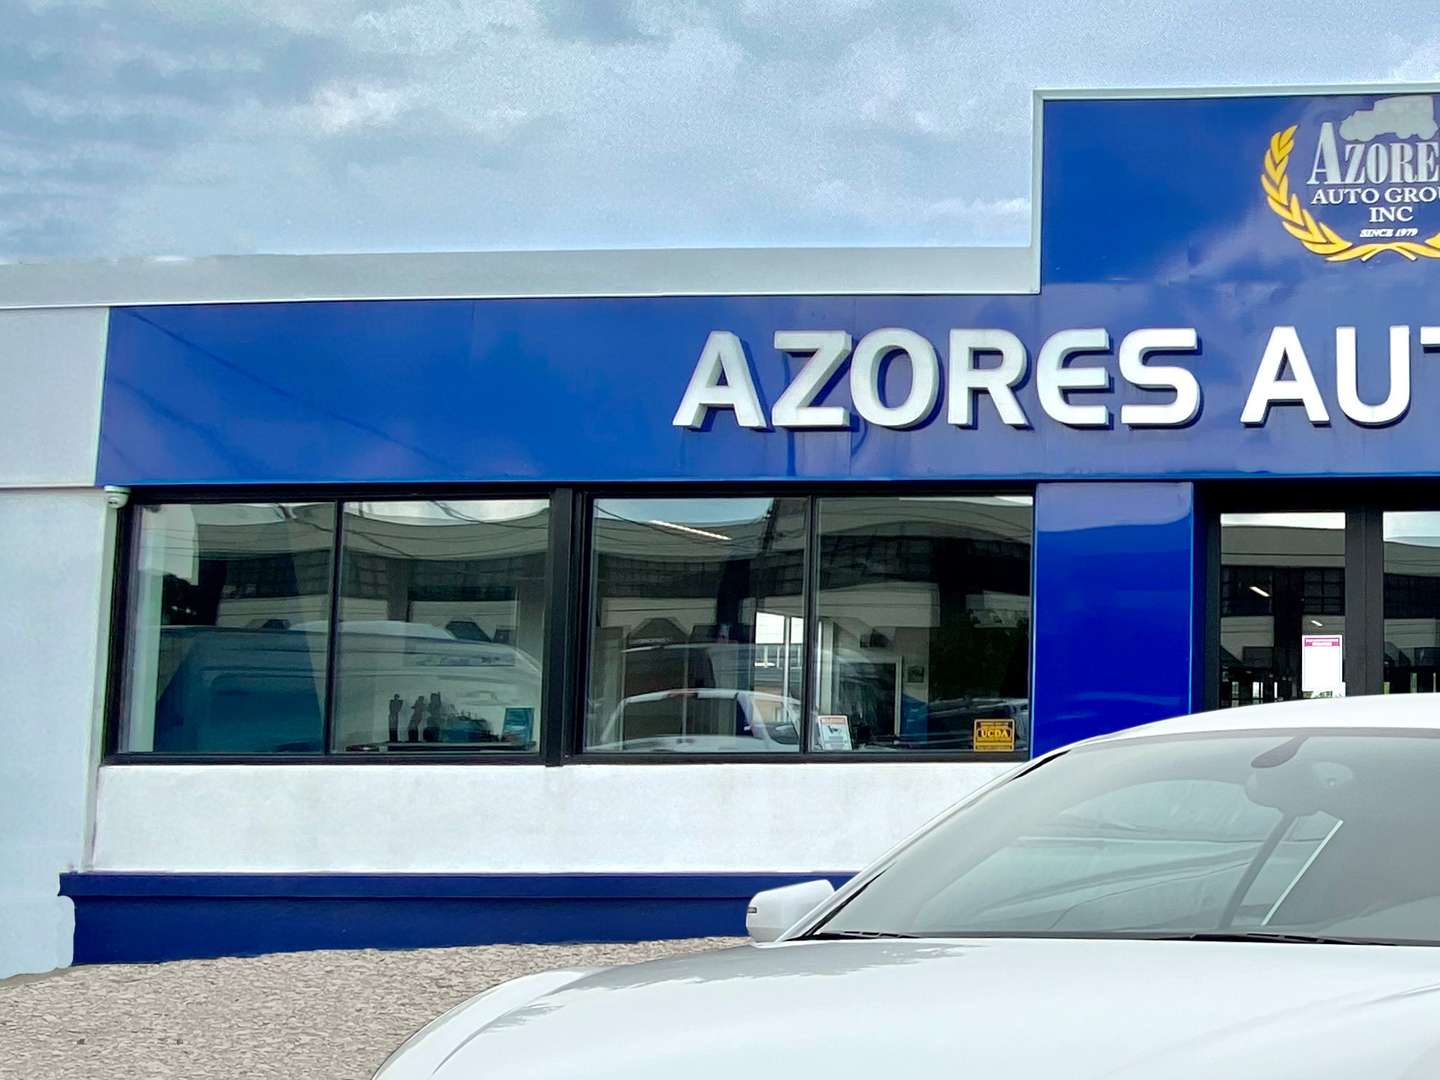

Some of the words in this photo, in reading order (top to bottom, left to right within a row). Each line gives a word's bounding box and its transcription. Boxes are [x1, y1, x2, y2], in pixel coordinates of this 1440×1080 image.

[1311, 187, 1379, 205] AUTO
[1368, 206, 1413, 222] INC
[1359, 228, 1393, 238] SINCE
[1394, 227, 1418, 237] 1979
[672, 327, 1203, 429] AZORES
[980, 729, 1009, 737] UCDA
